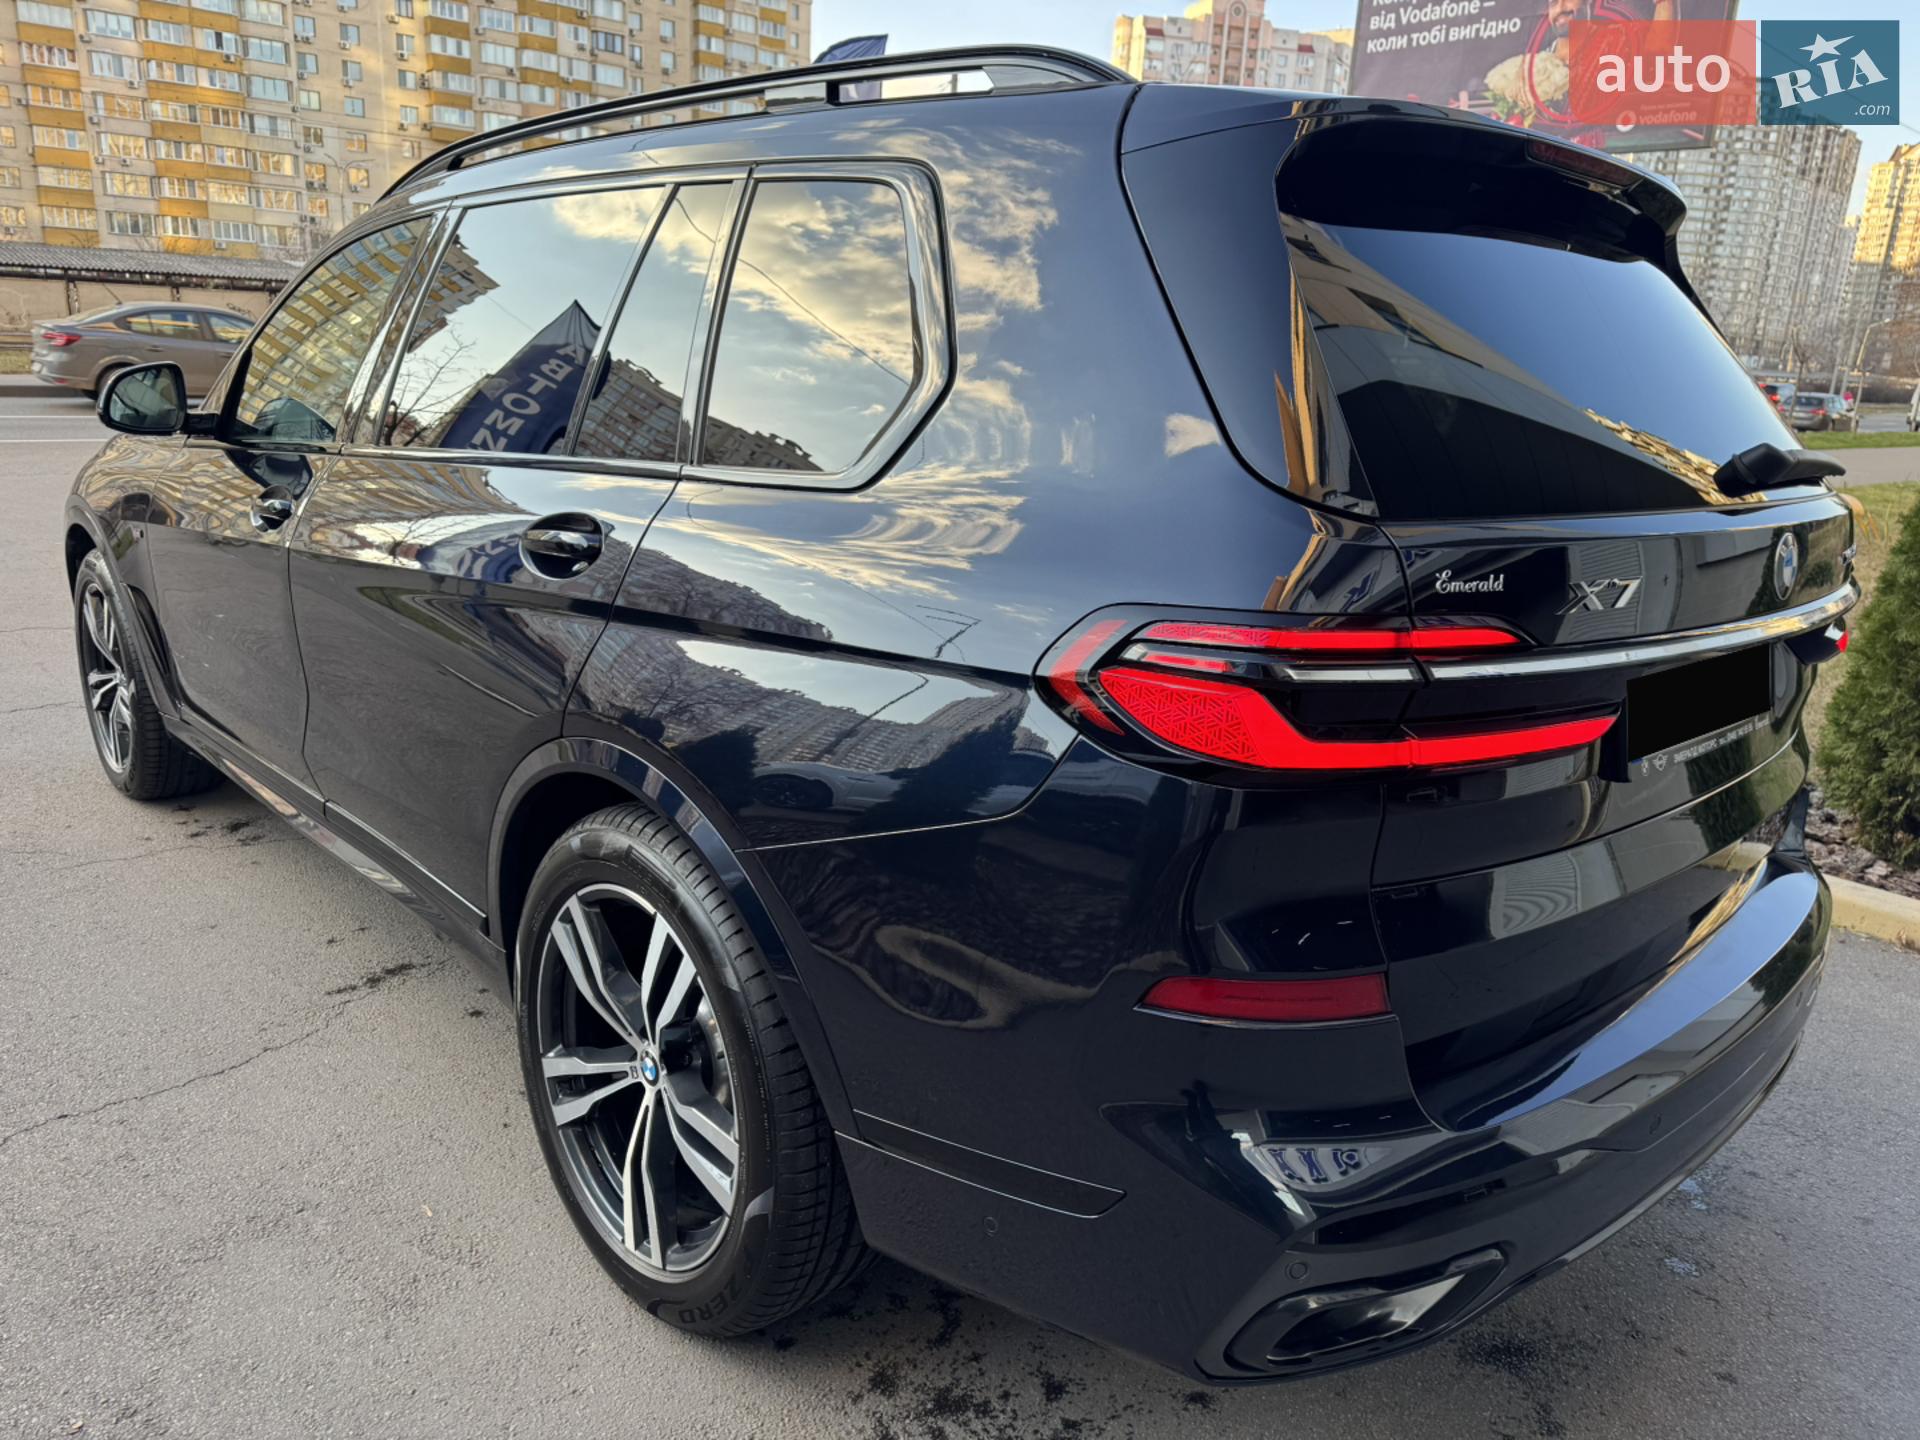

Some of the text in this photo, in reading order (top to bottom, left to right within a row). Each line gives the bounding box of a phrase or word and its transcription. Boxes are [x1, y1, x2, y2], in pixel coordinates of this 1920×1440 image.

[1369, 10, 1396, 30] від
[1400, 0, 1480, 26] Vodafone
[1367, 17, 1521, 54] коли тобі вигідно
[1639, 109, 1697, 126] vodafone
[1435, 569, 1504, 594] Emerald
[1555, 575, 1643, 615] X7
